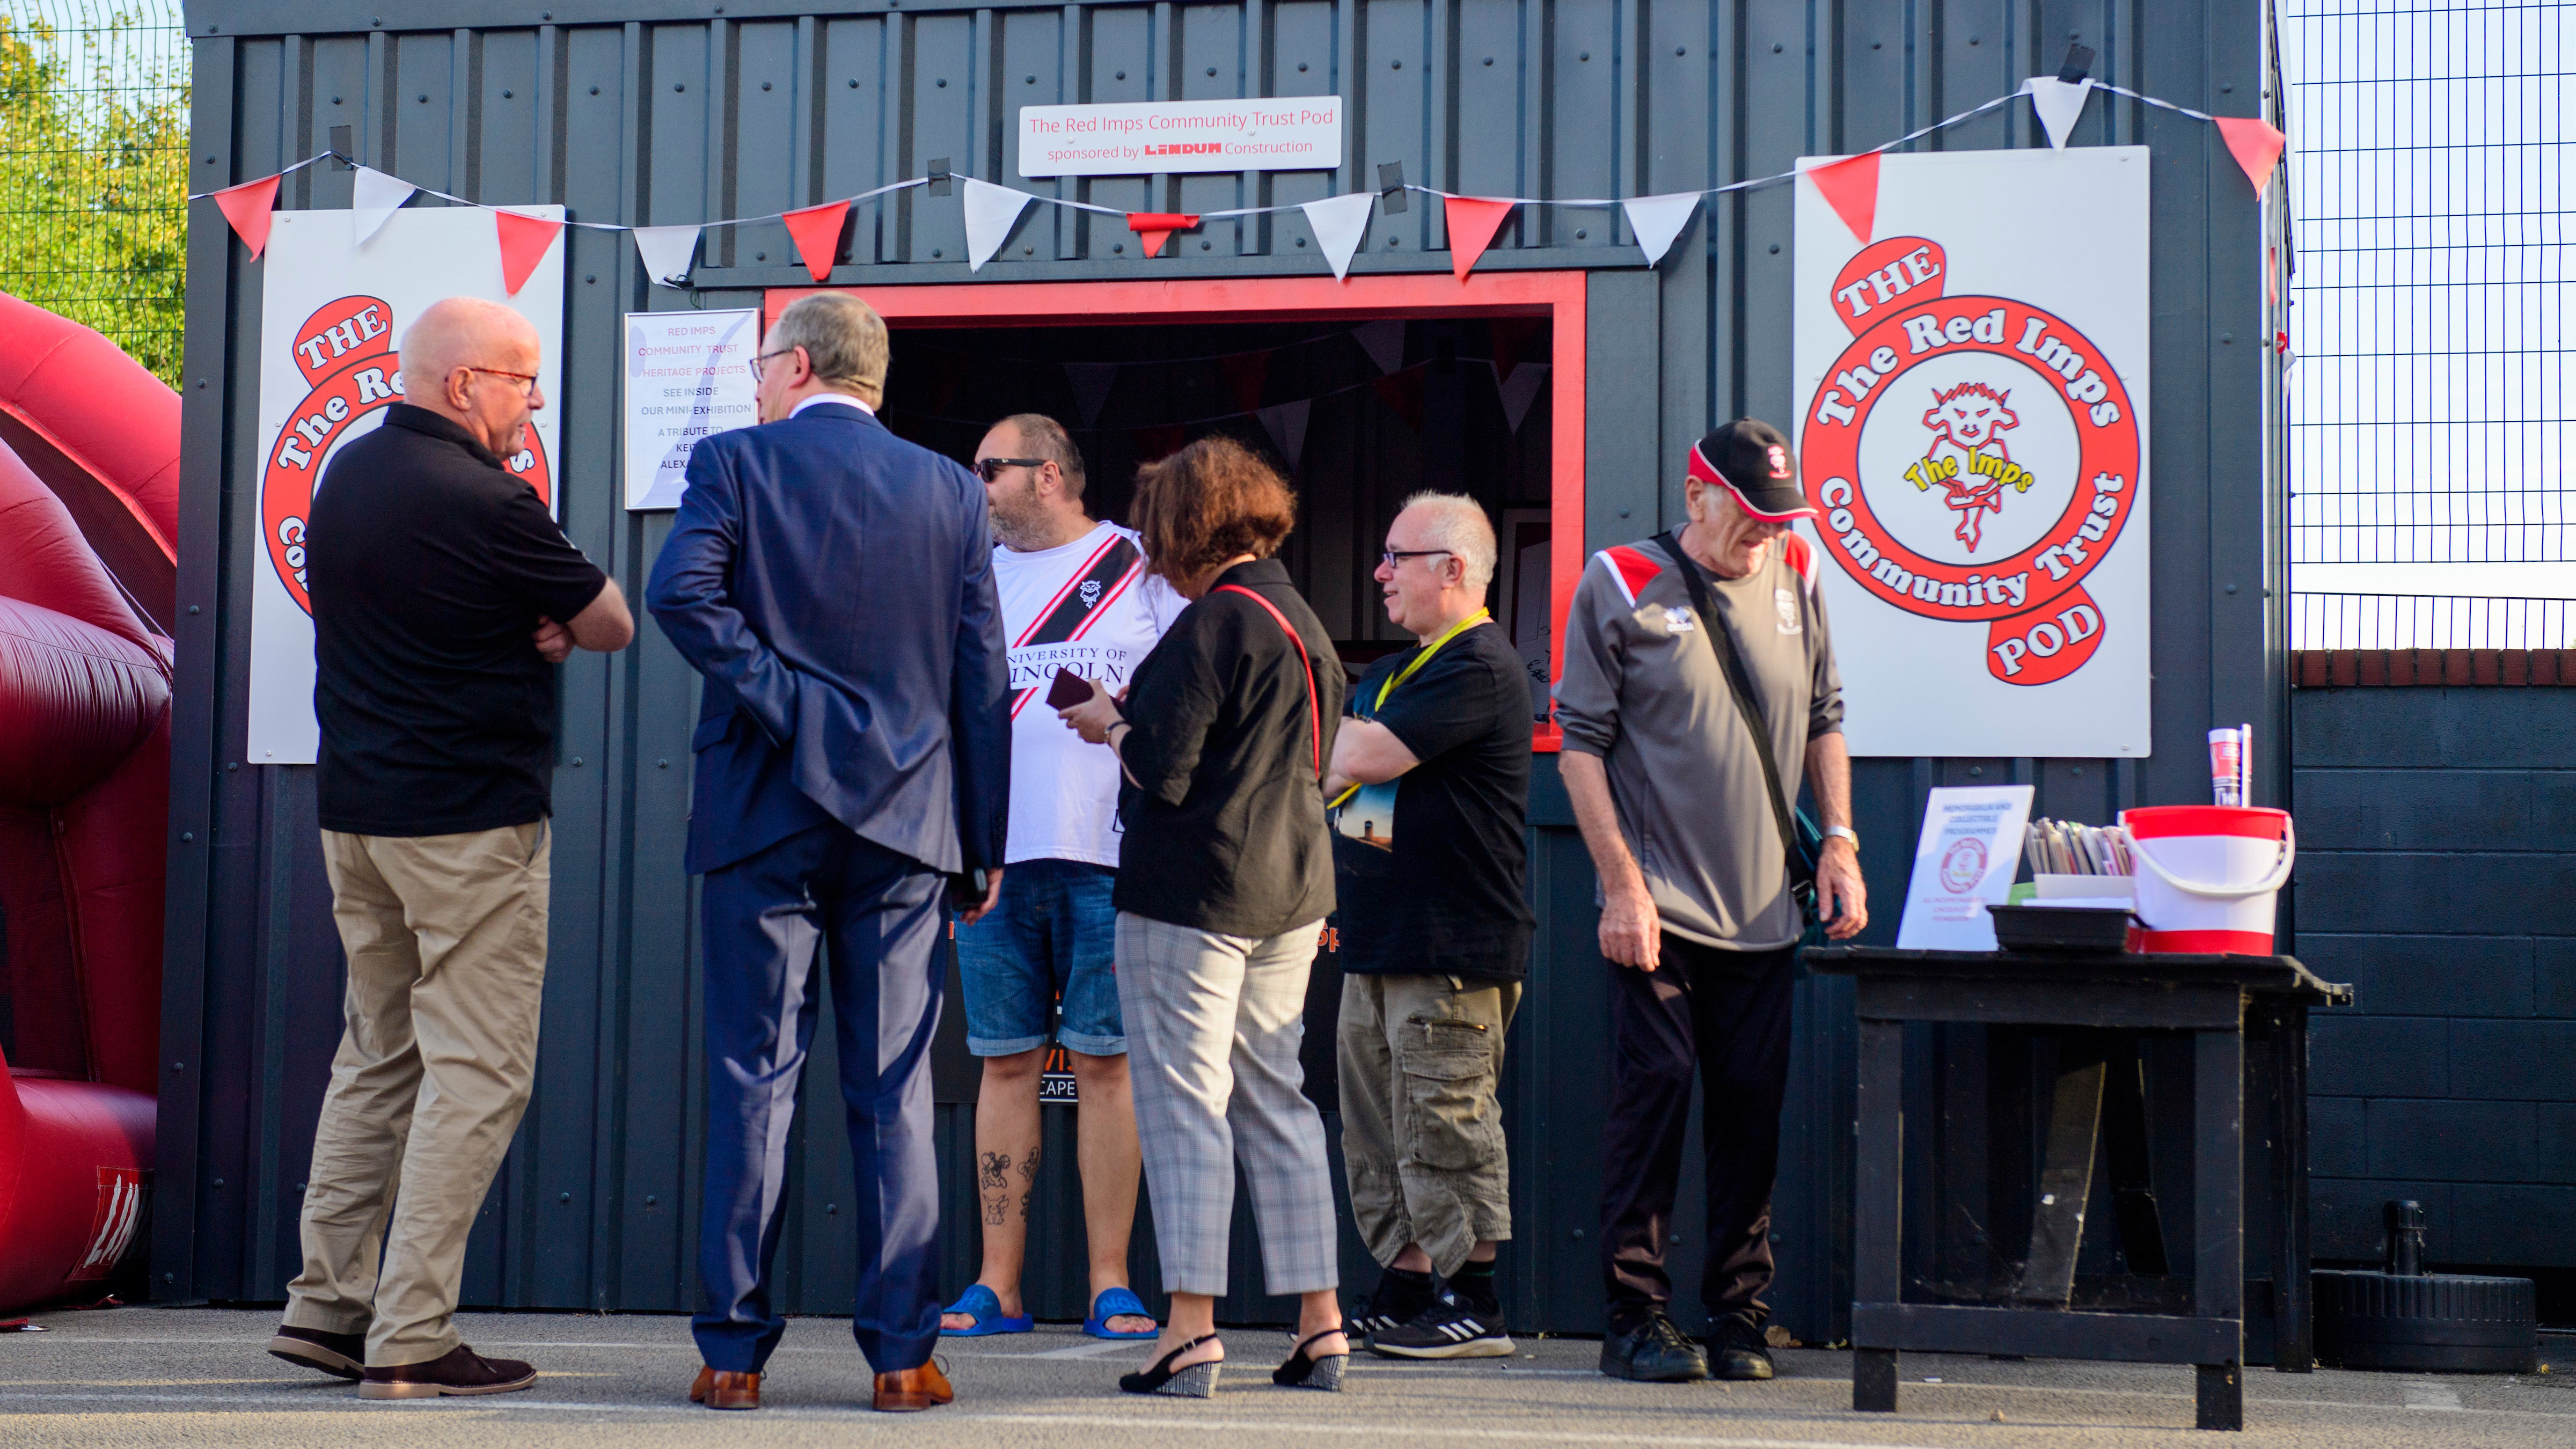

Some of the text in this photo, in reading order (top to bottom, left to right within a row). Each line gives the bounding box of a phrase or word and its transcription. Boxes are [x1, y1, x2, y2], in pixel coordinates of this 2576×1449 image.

[1029, 108, 1333, 135] The Red Imps Community Trust Pod
[1048, 145, 1118, 163] sponsored
[1124, 145, 1139, 161] by
[1225, 140, 1312, 155] Construction
[1837, 245, 1941, 317] THE
[298, 304, 387, 370] THE
[668, 326, 715, 336] RED IMPS
[639, 345, 738, 356] COMMUNITY TRUST
[643, 365, 746, 377] HERITAGE PROJECTS
[1817, 309, 2121, 428] The Red Imps
[663, 387, 719, 397] SEE INSIDE
[277, 367, 406, 471] The Re
[641, 404, 751, 415] OUR MINI-EXHIBITION
[658, 426, 723, 437] A TRIBUTE TO
[661, 460, 687, 469] ALEX
[1903, 446, 2034, 493] The Imps
[1820, 472, 2125, 609] Community Trust
[1992, 603, 2099, 676] POD
[1007, 648, 1127, 664] NIVERSITY OF
[1011, 662, 1124, 684] INCOLN
